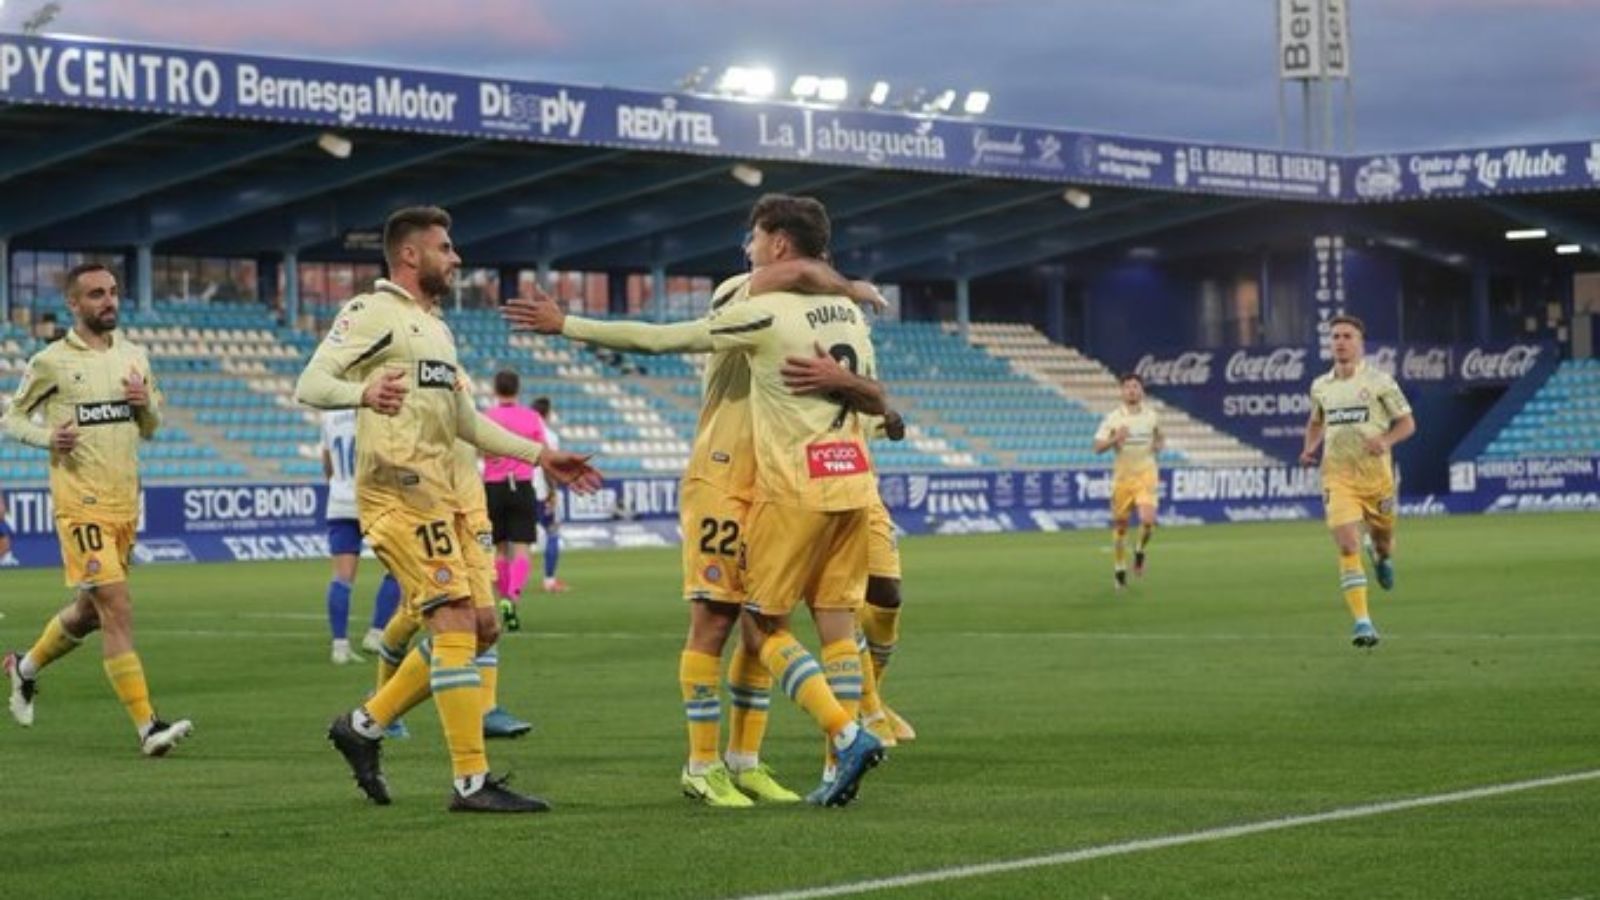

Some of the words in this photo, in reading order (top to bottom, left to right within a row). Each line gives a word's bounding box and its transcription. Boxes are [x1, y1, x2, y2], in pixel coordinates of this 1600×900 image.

[0, 45, 220, 106] PYCENTRO
[237, 64, 372, 122] Bernesga
[375, 76, 456, 121] Motor
[617, 104, 719, 146] REDYTEL
[758, 113, 794, 147] La
[1475, 151, 1501, 189] La
[1503, 148, 1566, 180] Nube
[806, 304, 857, 329] PUADO
[79, 404, 132, 422] betwa
[622, 479, 680, 514] FRUT
[1173, 468, 1265, 500] EMBUTIDOS
[1268, 466, 1322, 499] PAJAR
[74, 523, 104, 553] 10
[416, 520, 453, 558] 15
[700, 517, 740, 556] 22
